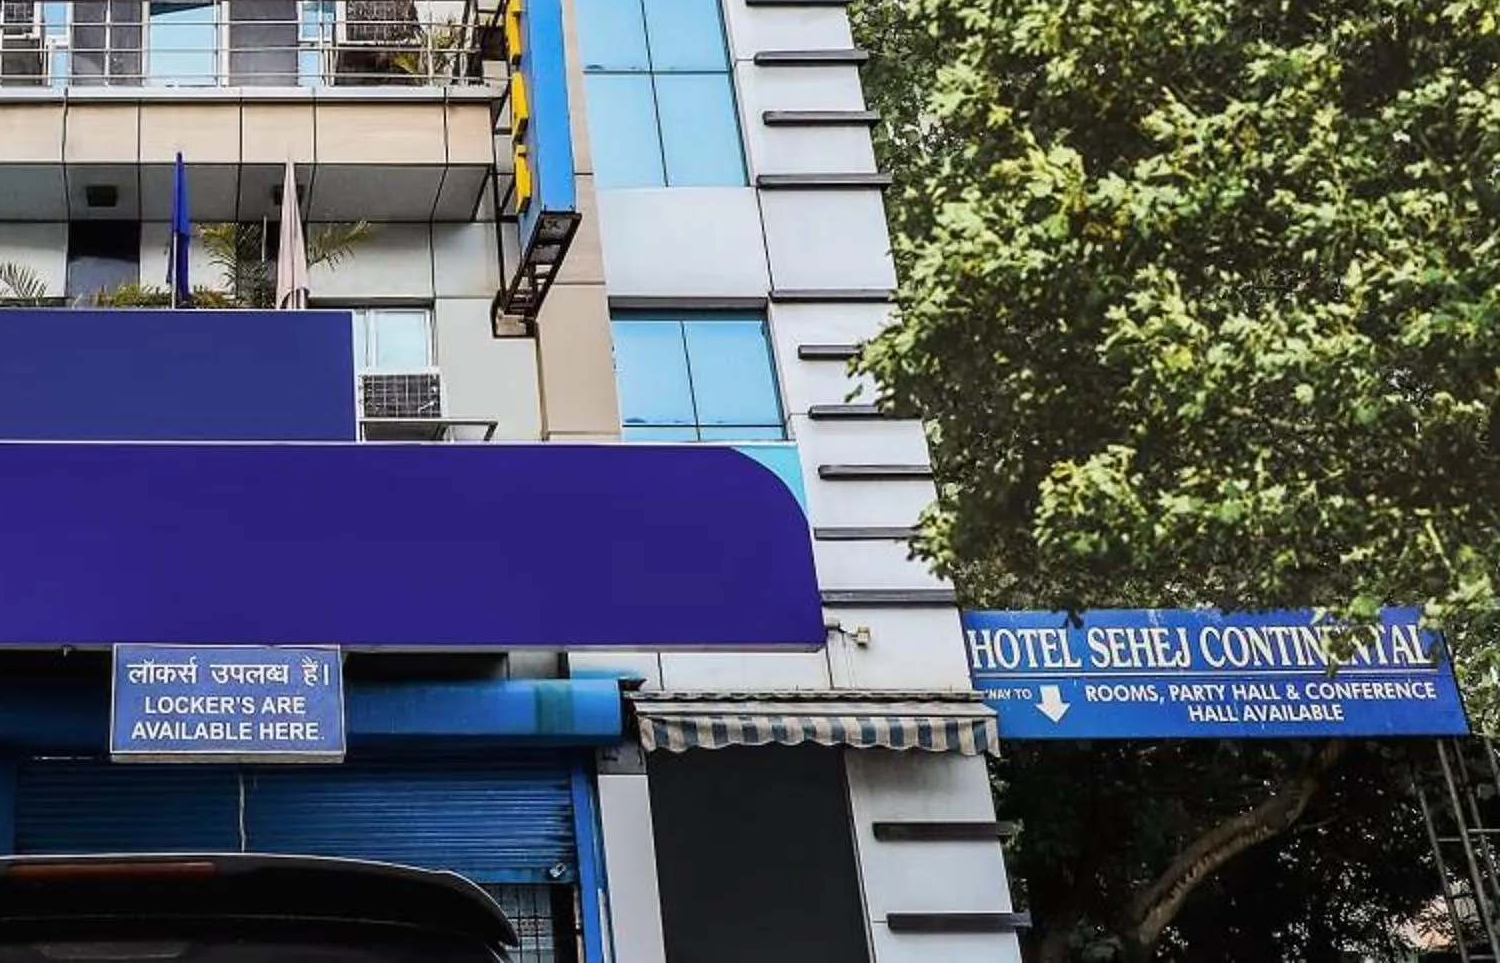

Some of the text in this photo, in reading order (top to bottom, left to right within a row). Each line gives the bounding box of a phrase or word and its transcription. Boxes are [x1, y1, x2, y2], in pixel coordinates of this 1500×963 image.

[967, 627, 1082, 669] HOTEL
[1087, 626, 1192, 669] SEHEJ
[127, 656, 198, 684] लॉकर्स
[209, 664, 289, 684] उपलब्ध
[1013, 687, 1033, 700] TO
[1084, 681, 1437, 705] ROOMS, PARTY HALL & CONFERENCE
[144, 696, 306, 715] LOCKER'S ARE
[1187, 703, 1345, 722] HALL AVAILABLE
[131, 721, 326, 740] AVAILABLE HERE.
